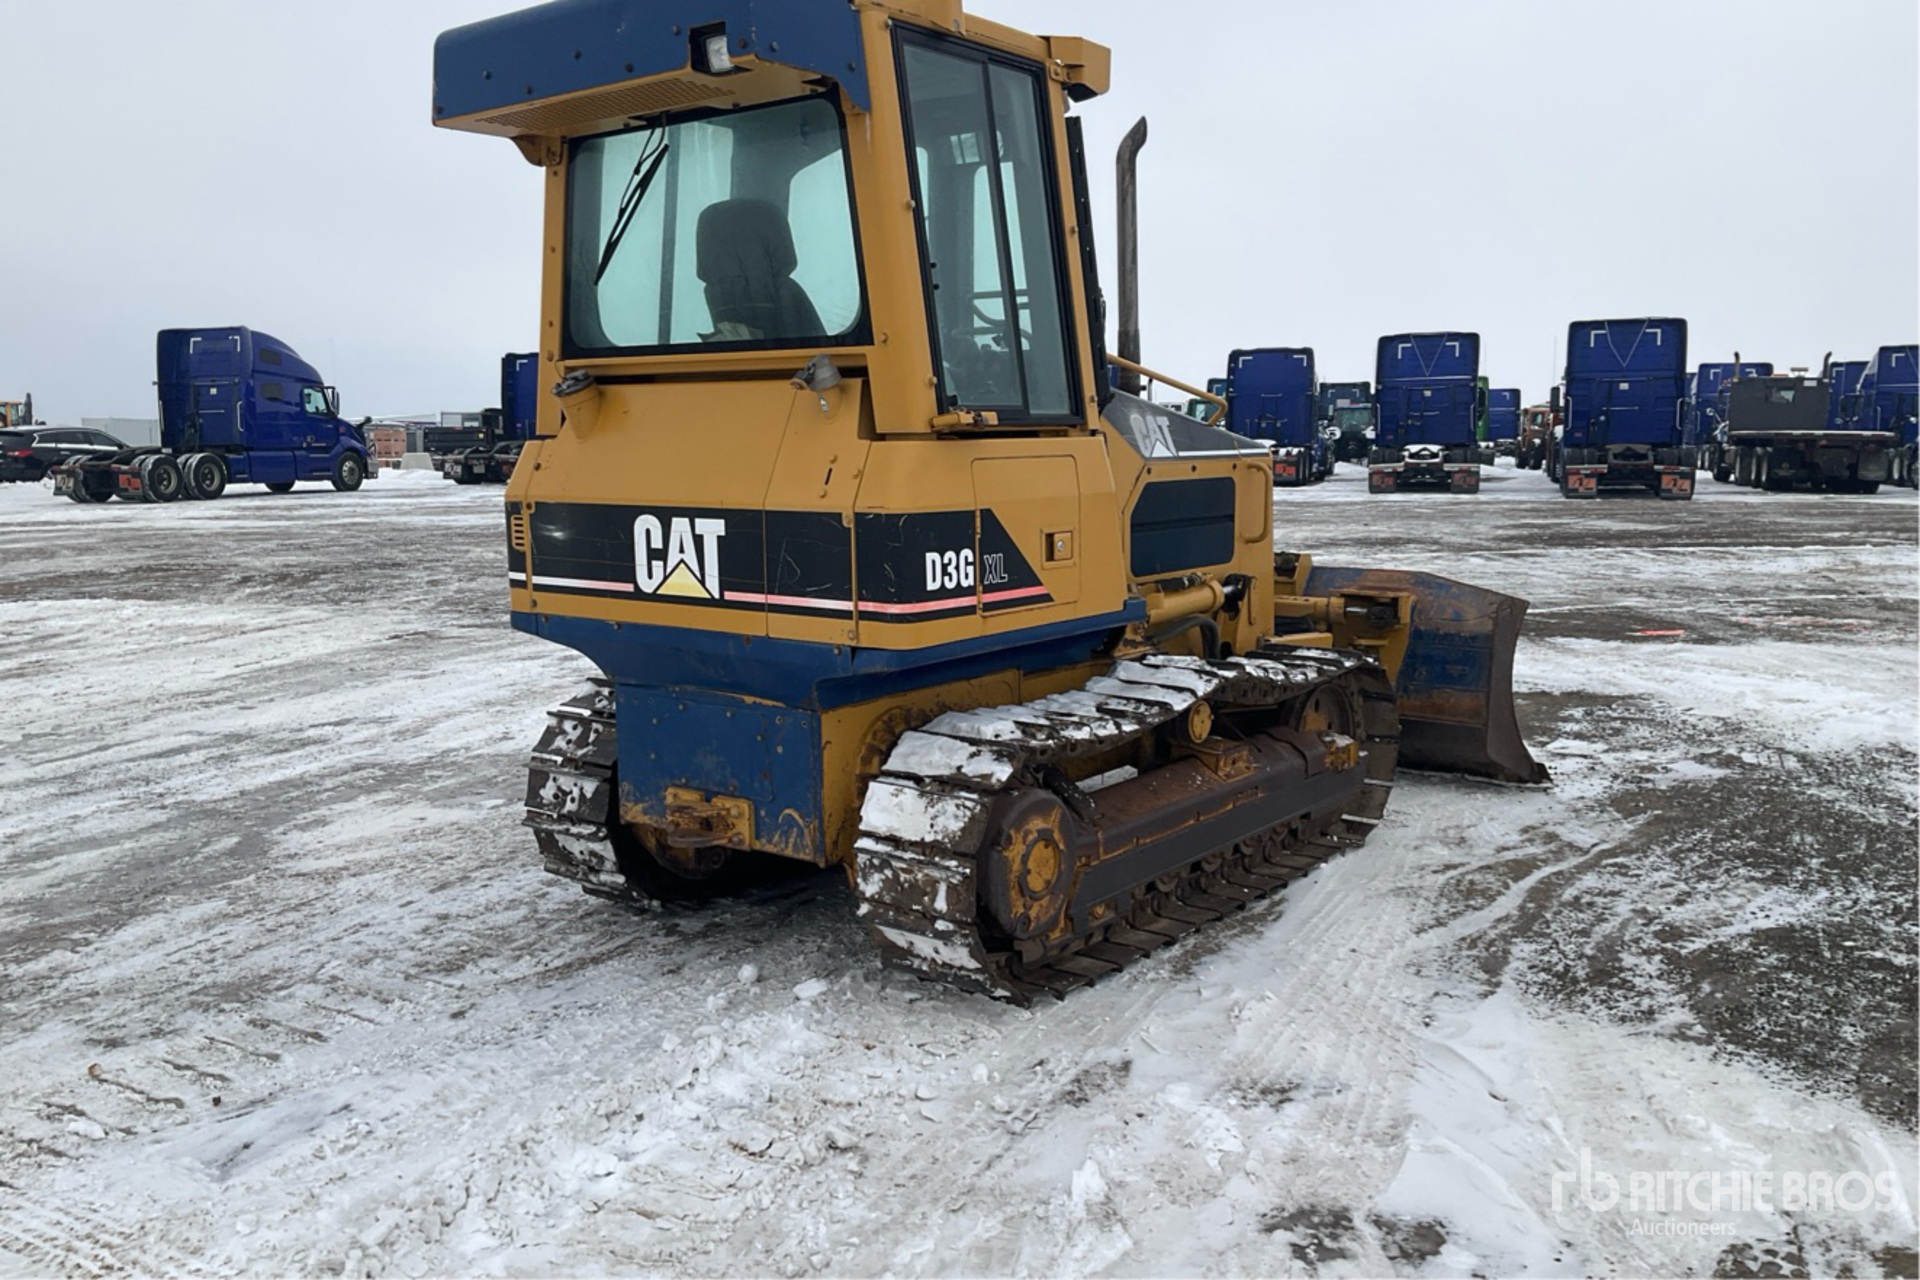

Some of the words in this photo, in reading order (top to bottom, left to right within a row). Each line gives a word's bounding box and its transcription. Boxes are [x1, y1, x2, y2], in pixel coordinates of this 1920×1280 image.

[1130, 413, 1178, 458] CAT
[633, 513, 726, 599] CAT
[925, 547, 975, 592] D3G
[983, 552, 1009, 585] XL
